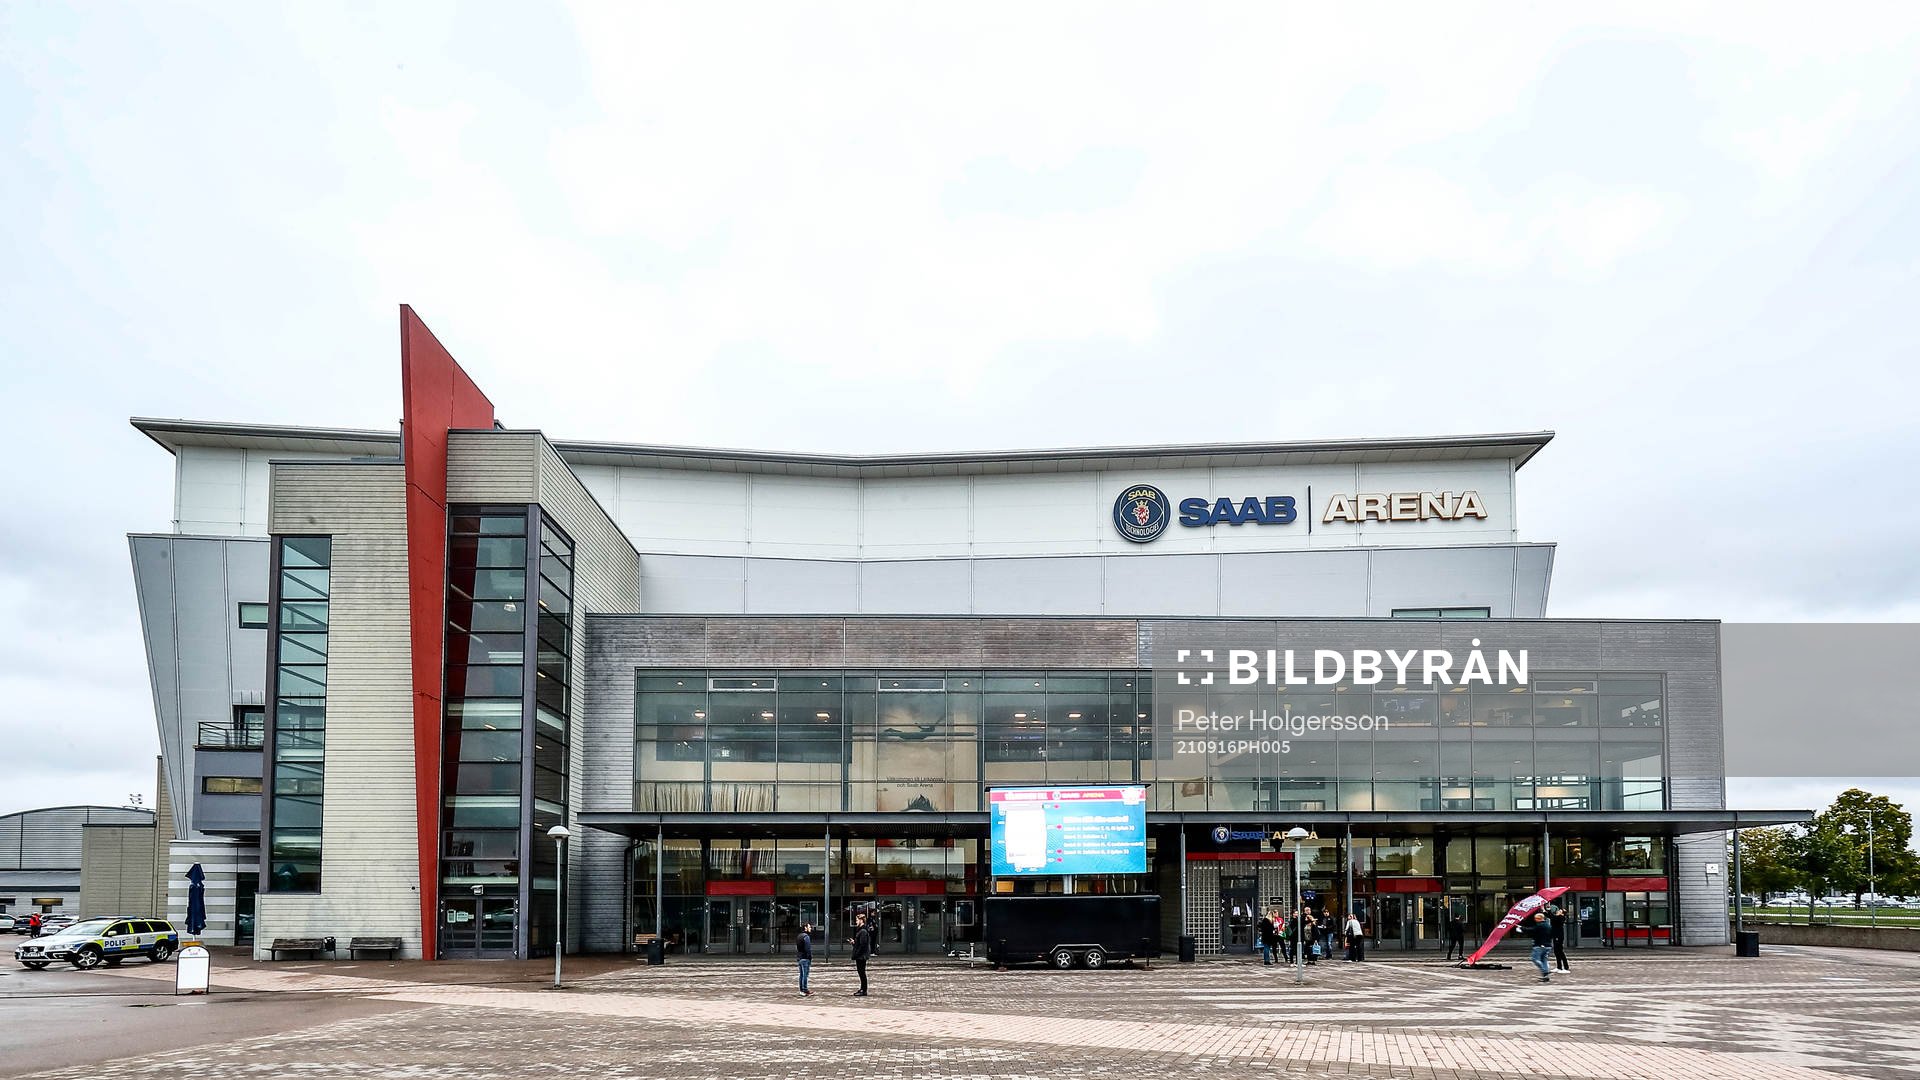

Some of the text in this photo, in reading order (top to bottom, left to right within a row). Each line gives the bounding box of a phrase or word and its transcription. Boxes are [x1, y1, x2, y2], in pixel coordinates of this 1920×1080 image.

[1128, 490, 1156, 500] SAAB
[1178, 491, 1488, 527] SAAB ARENA
[1125, 522, 1160, 536] TECHNOLOGIES
[1231, 831, 1265, 840] SAAB
[1272, 831, 1319, 840] ARA
[104, 939, 126, 948] POLIS
